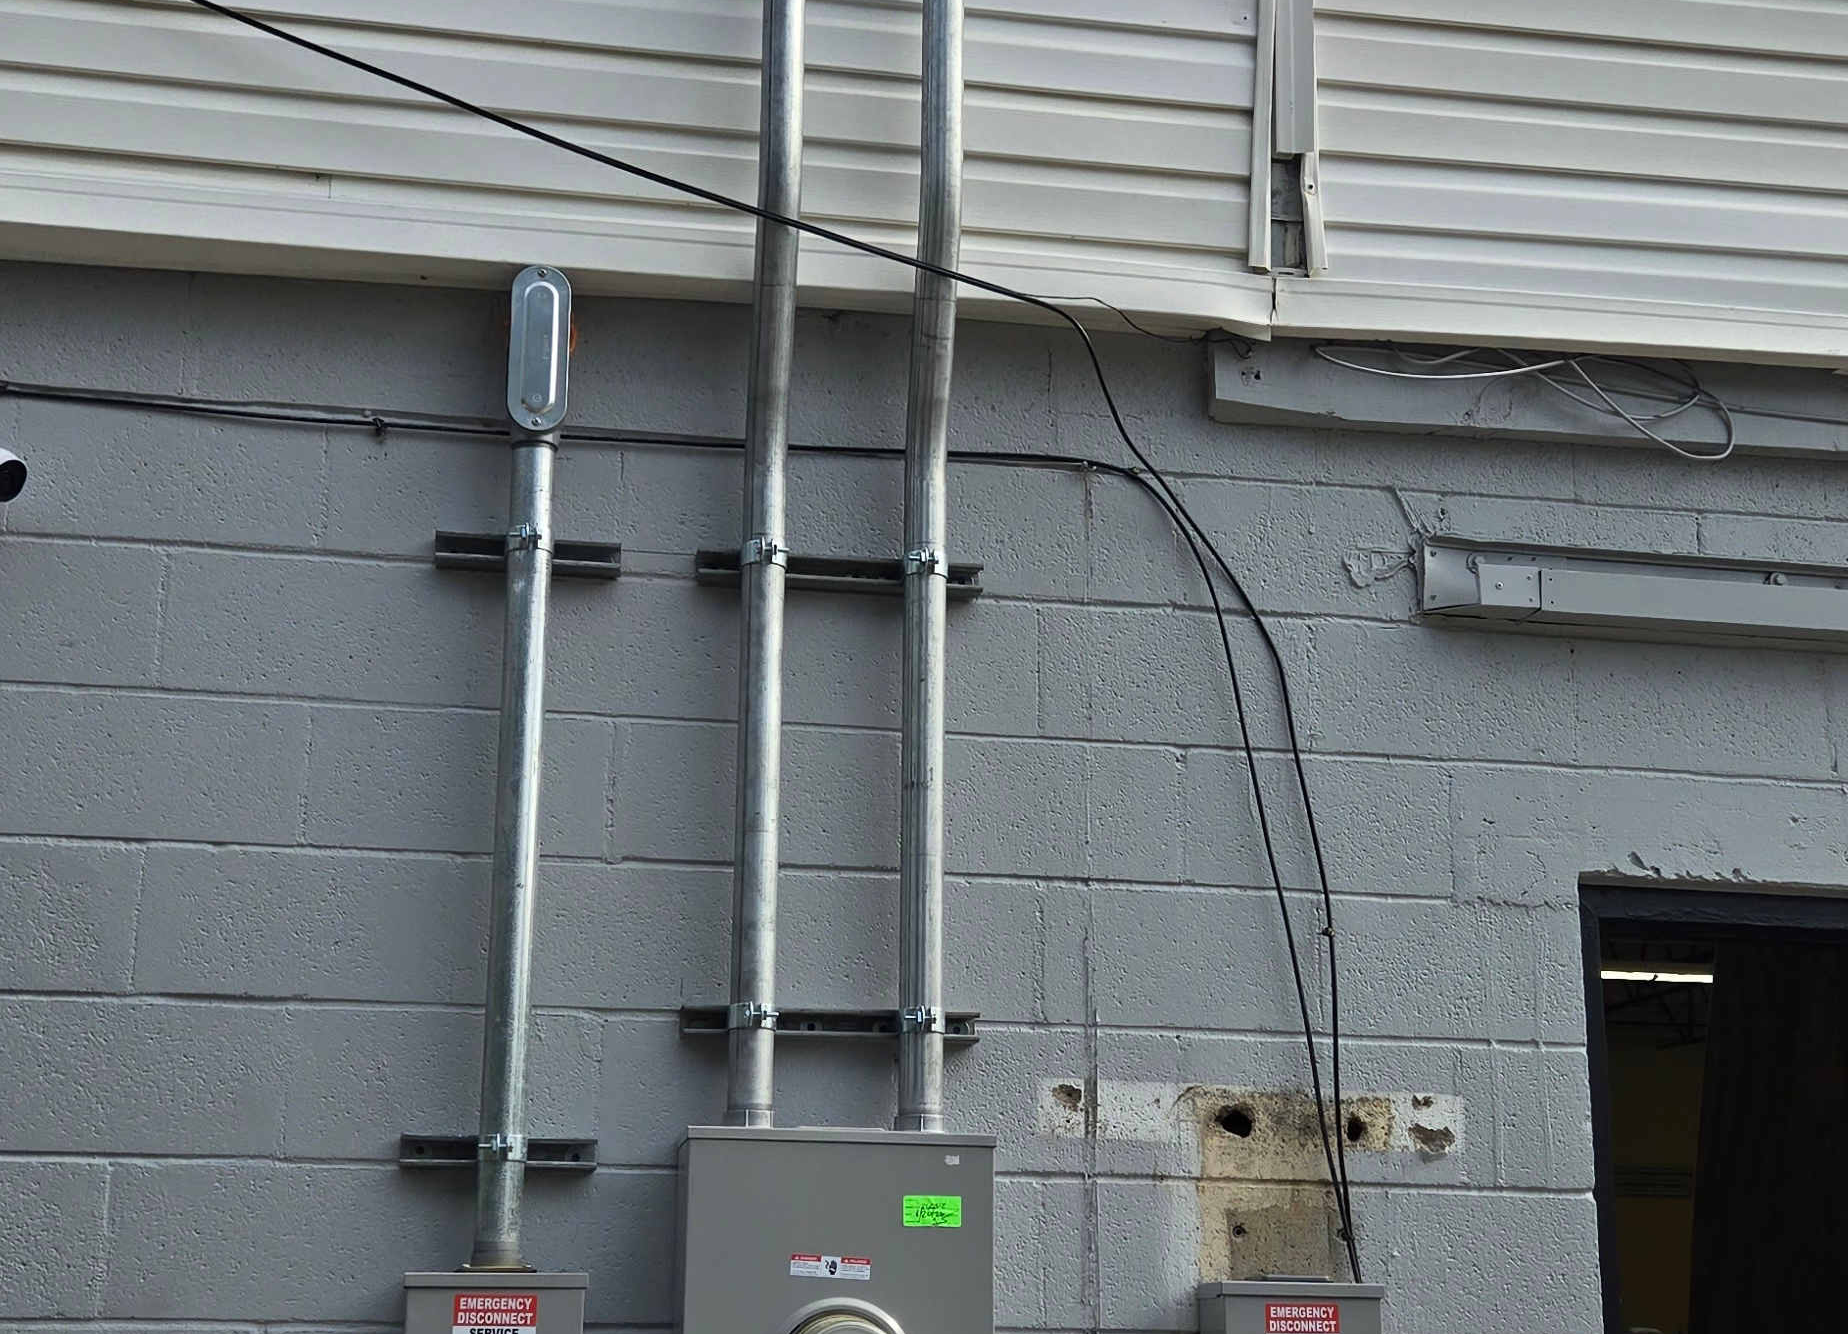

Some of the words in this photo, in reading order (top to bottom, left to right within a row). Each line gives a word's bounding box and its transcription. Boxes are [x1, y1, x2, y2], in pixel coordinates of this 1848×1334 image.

[459, 1297, 533, 1311] EMERGENCY
[457, 1312, 534, 1325] DISCONNECT
[1270, 1306, 1335, 1319] EMERGENCY
[1269, 1320, 1337, 1333] DISCONNECT
